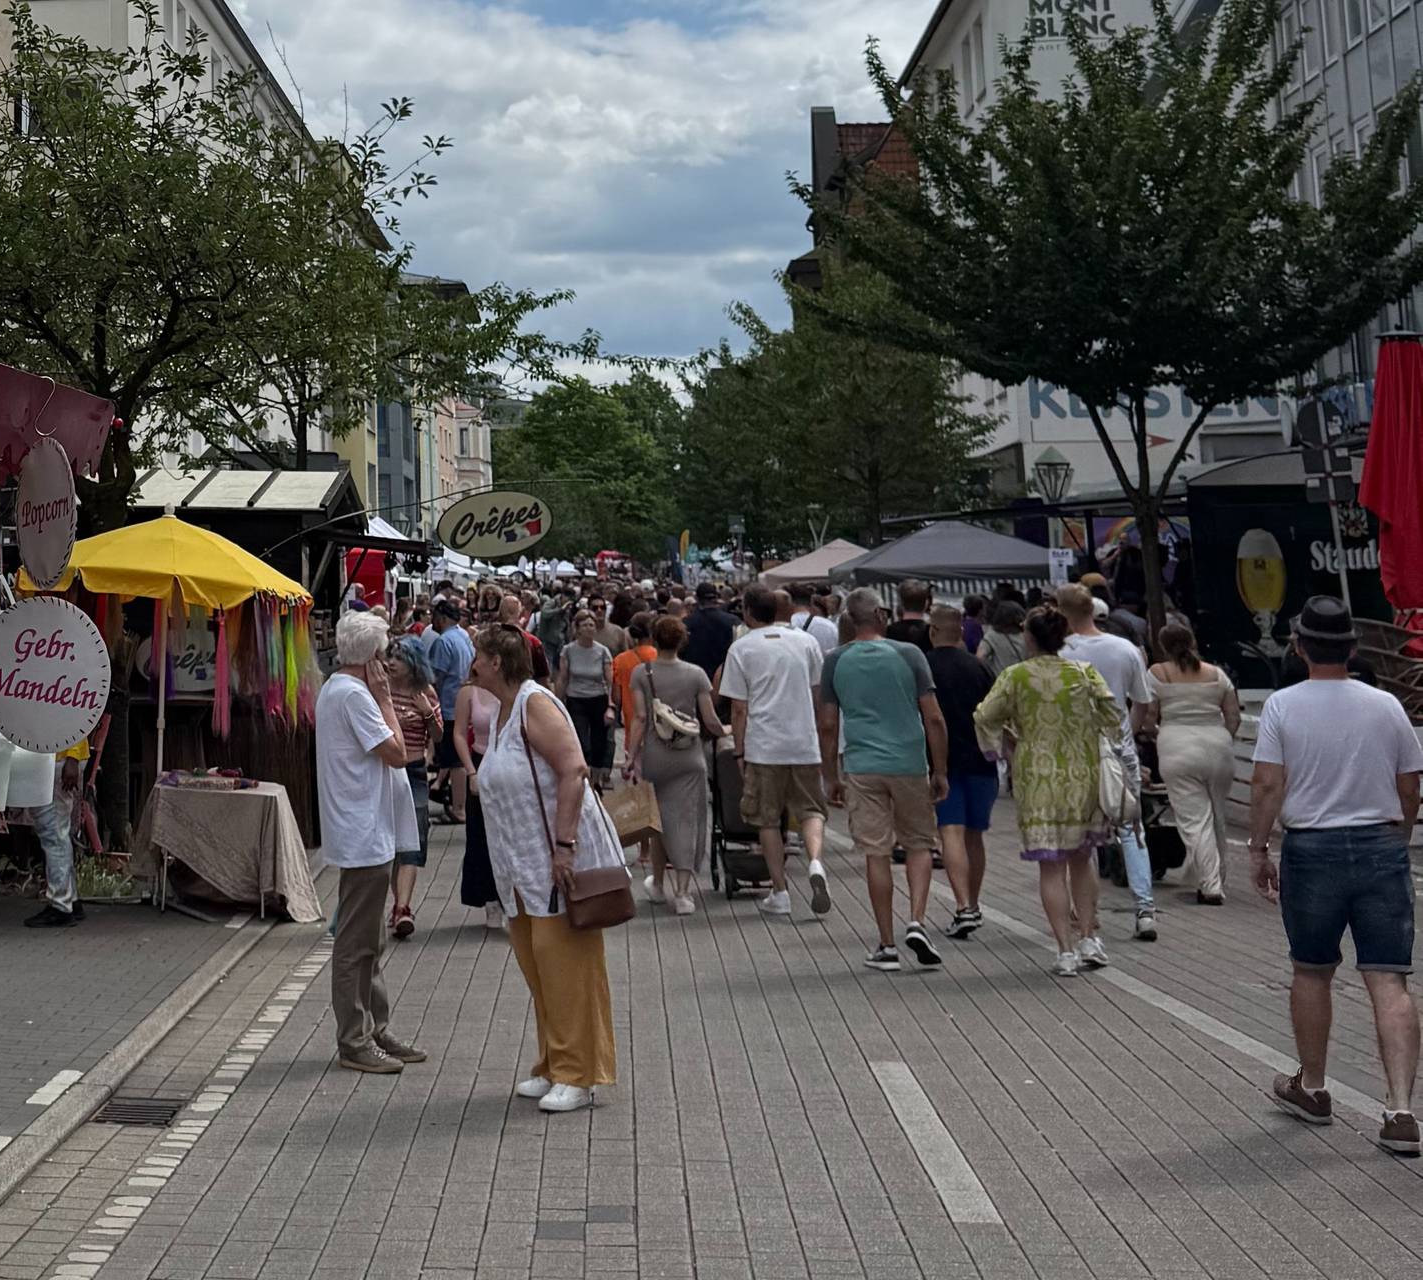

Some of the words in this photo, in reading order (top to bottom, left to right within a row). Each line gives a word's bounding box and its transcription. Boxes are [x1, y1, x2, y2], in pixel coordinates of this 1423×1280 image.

[21, 496, 70, 535] Popcorn
[449, 502, 543, 550] Crêpes
[14, 628, 75, 663] Gebr.
